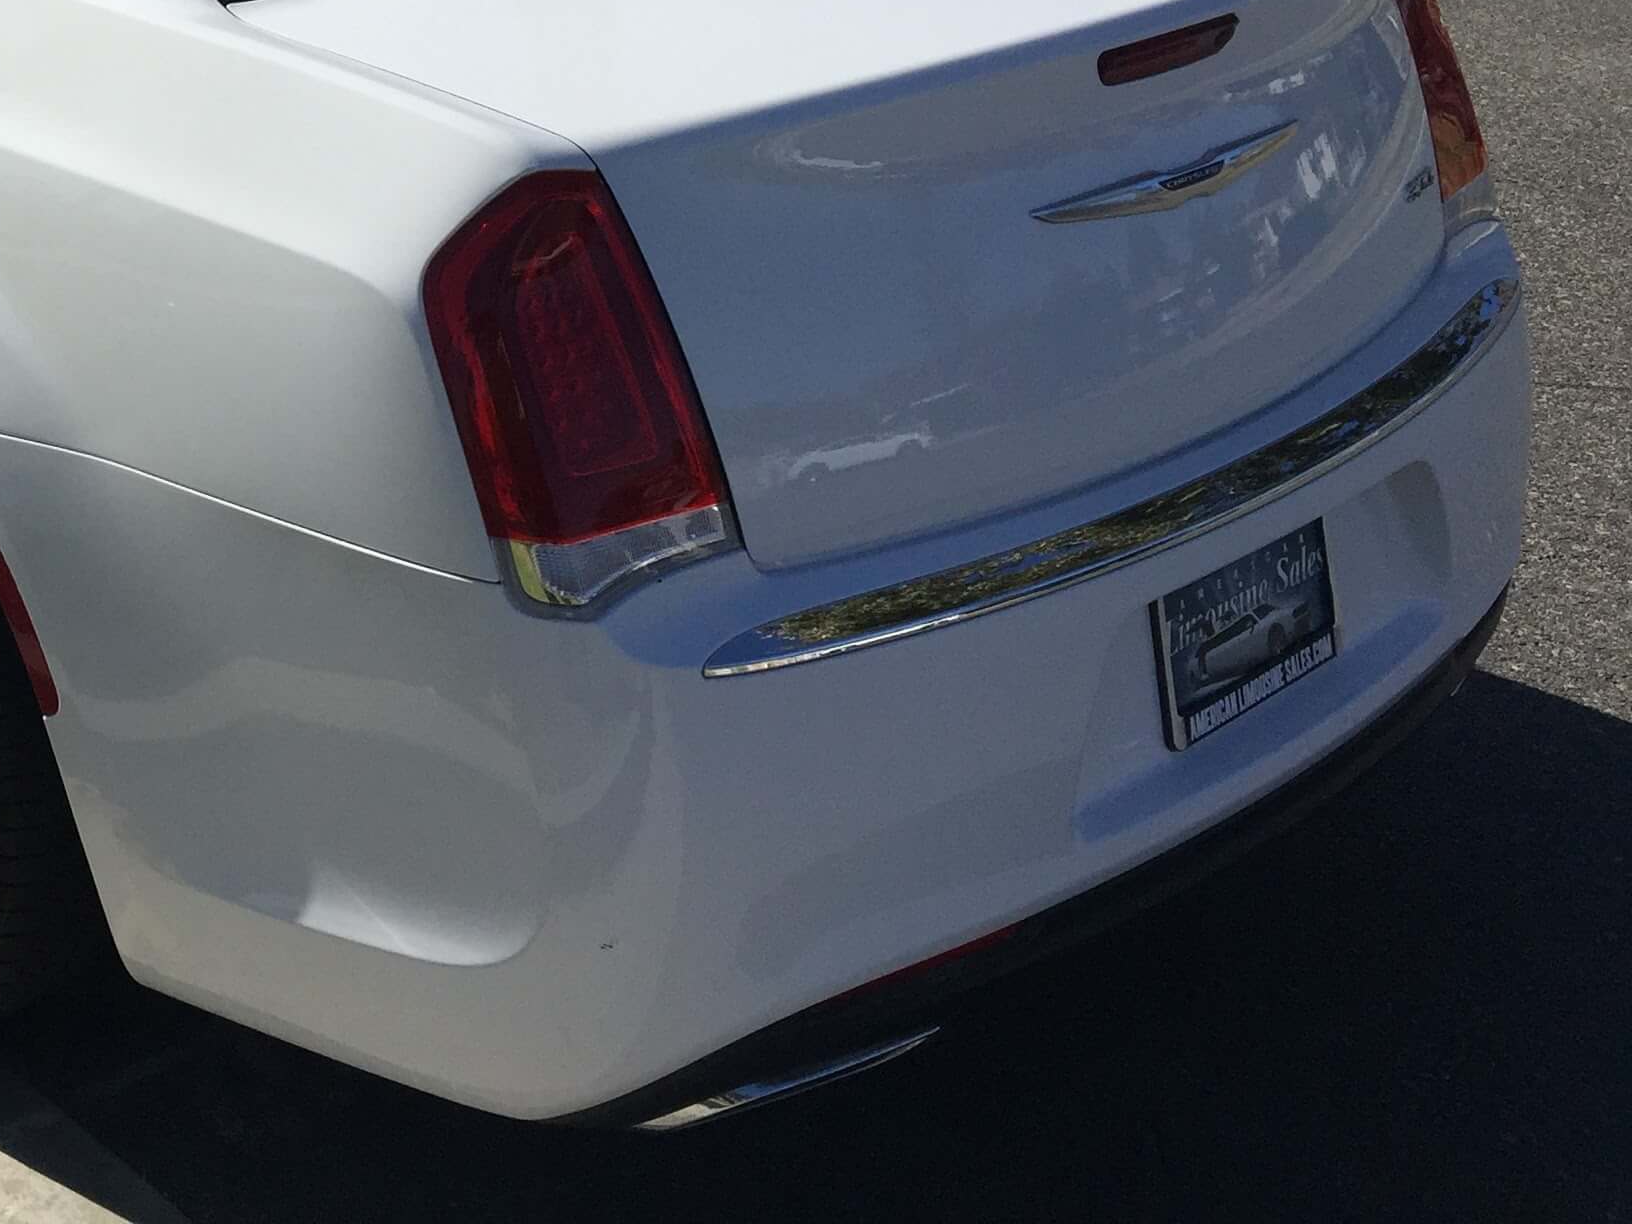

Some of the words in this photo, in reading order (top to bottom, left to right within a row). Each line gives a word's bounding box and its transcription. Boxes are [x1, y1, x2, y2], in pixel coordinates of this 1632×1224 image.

[1168, 577, 1272, 655] Limousine
[1275, 544, 1324, 593] Sales
[1189, 689, 1238, 741] AMERICAN
[1237, 663, 1286, 713] LIMOUSINE
